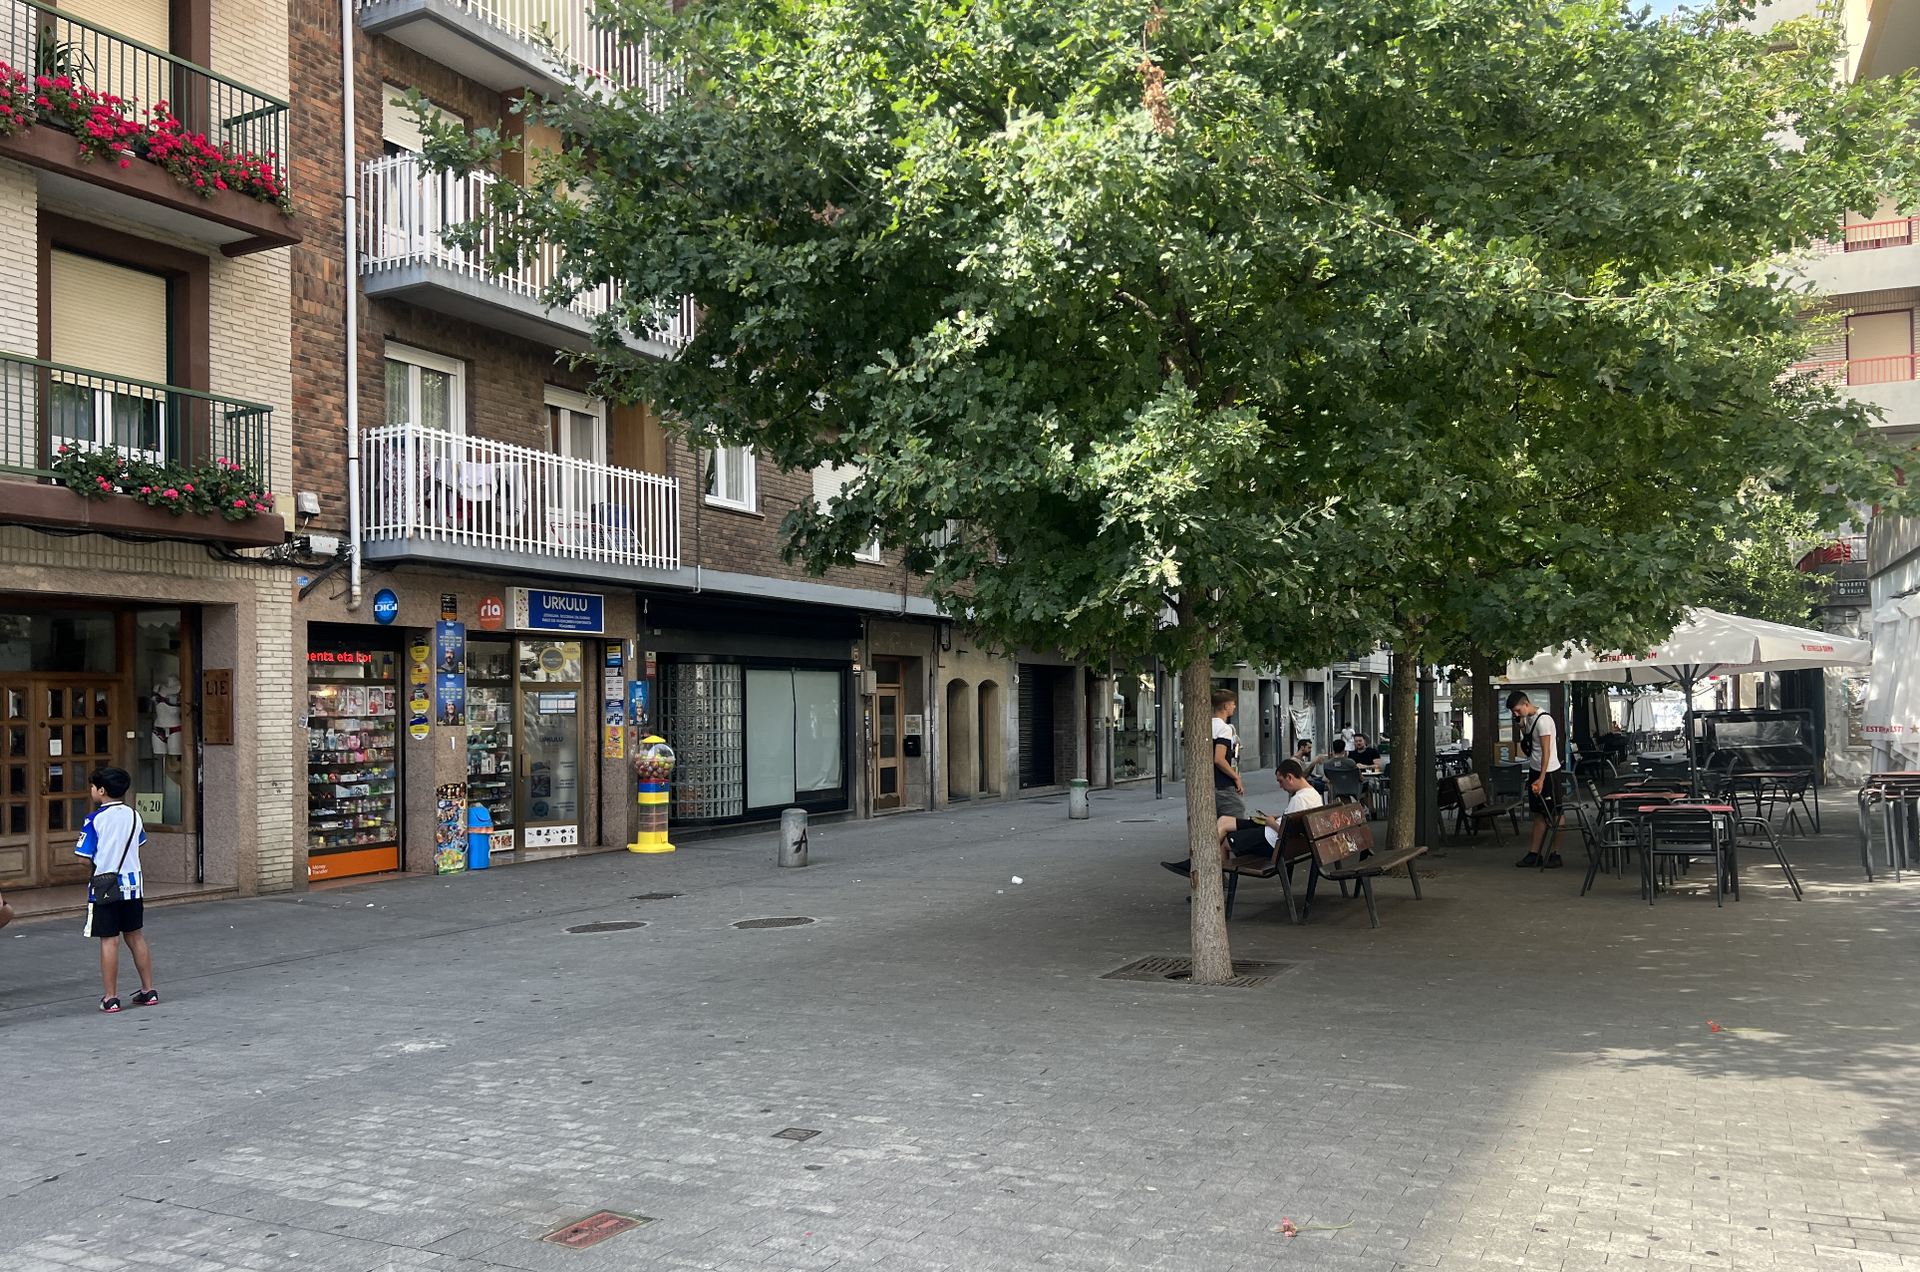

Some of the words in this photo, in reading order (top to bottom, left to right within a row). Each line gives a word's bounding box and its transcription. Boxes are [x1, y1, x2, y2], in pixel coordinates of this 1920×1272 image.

[374, 603, 398, 612] DIGI
[480, 599, 501, 617] ria
[543, 595, 588, 611] URKULU
[337, 651, 354, 663] eta
[206, 681, 228, 695] LIE
[150, 800, 161, 813] 20
